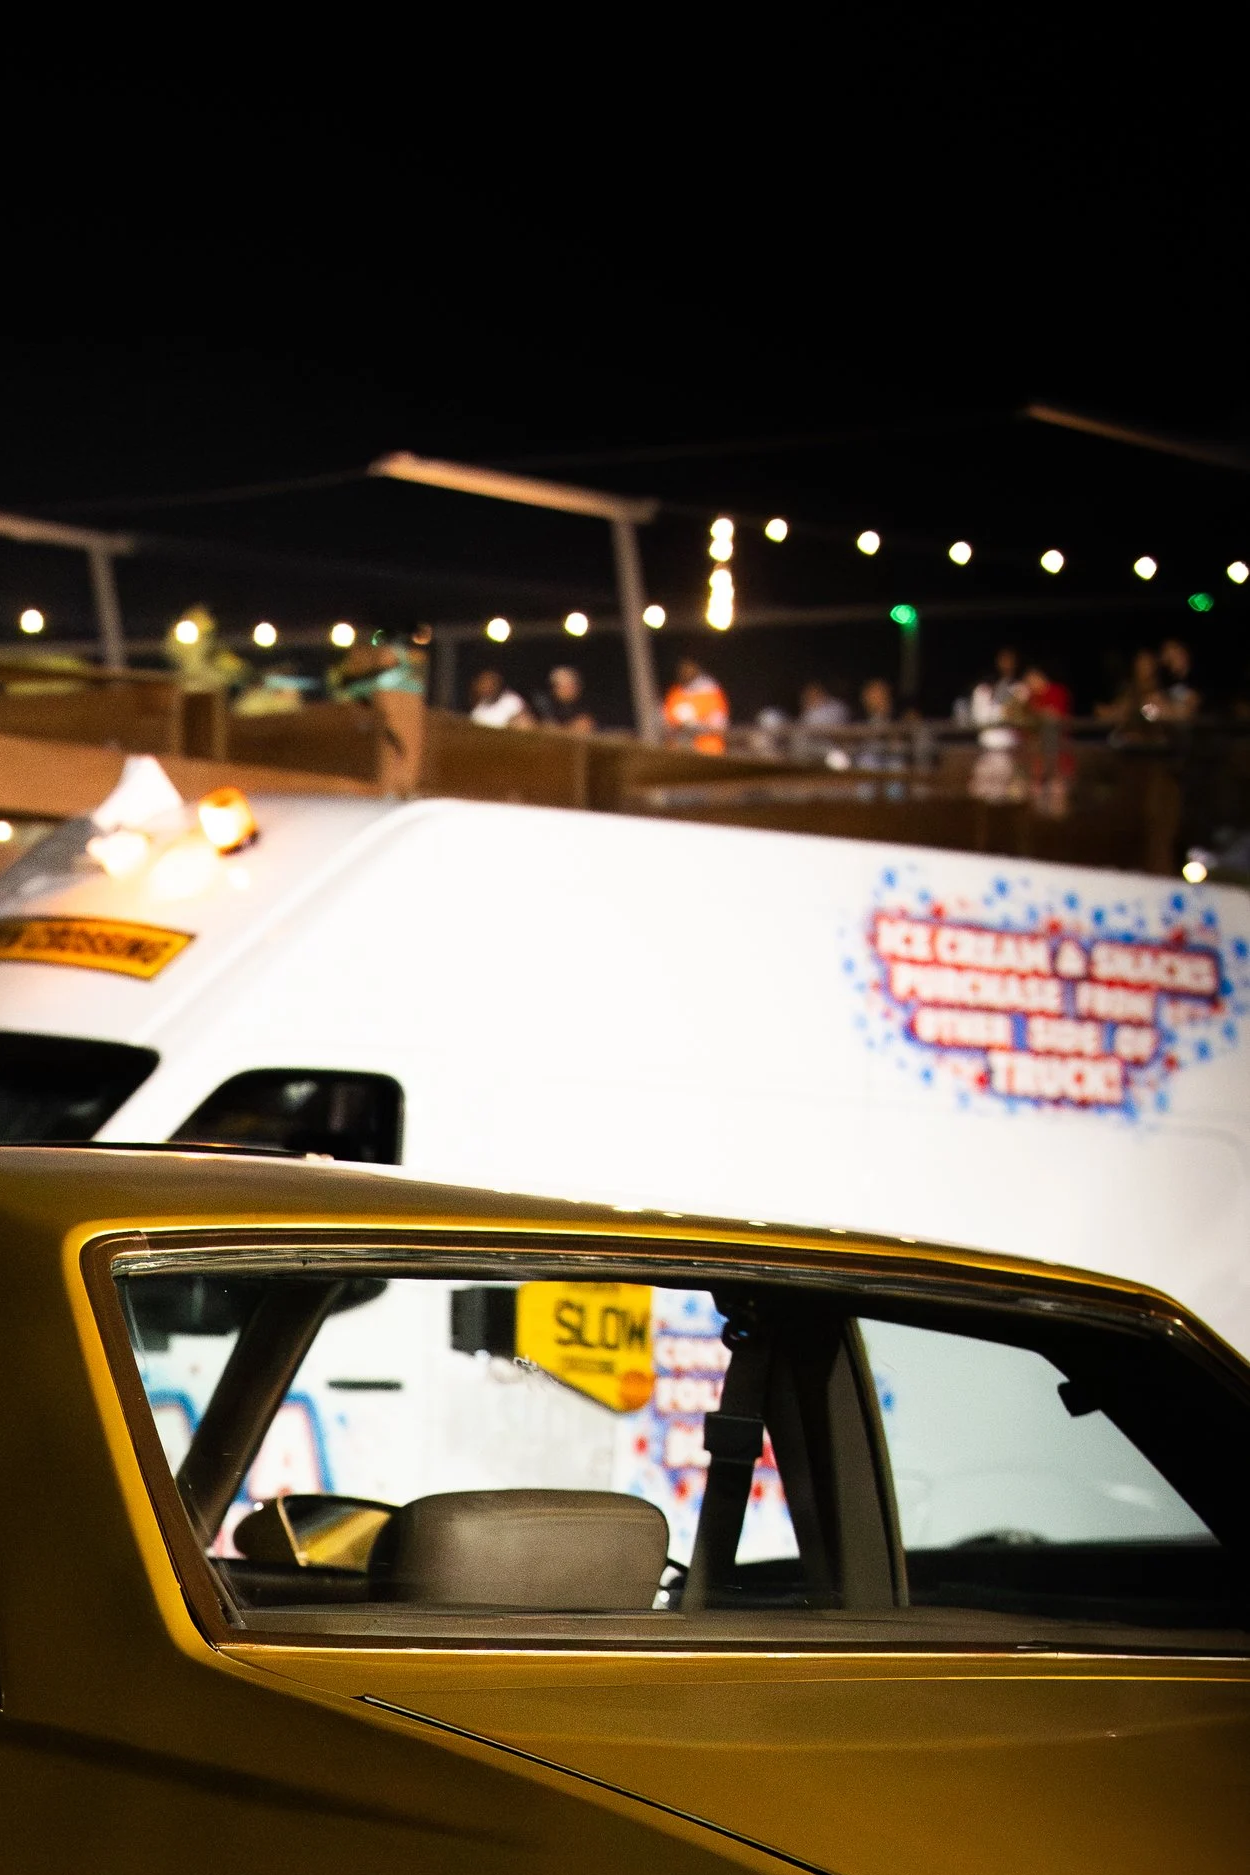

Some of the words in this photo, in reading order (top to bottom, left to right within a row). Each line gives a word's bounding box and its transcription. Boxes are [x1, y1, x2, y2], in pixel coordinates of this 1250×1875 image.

[874, 916, 930, 962] ICE
[935, 924, 1049, 976] CREAM
[1055, 939, 1088, 978] &
[1091, 944, 1218, 996] SNACKS
[891, 962, 1062, 1015] PURCHASE
[1075, 982, 1154, 1025] FROM
[1027, 1015, 1102, 1057] SIDE
[1112, 1024, 1156, 1063] OF
[553, 1298, 651, 1352] SLOW
